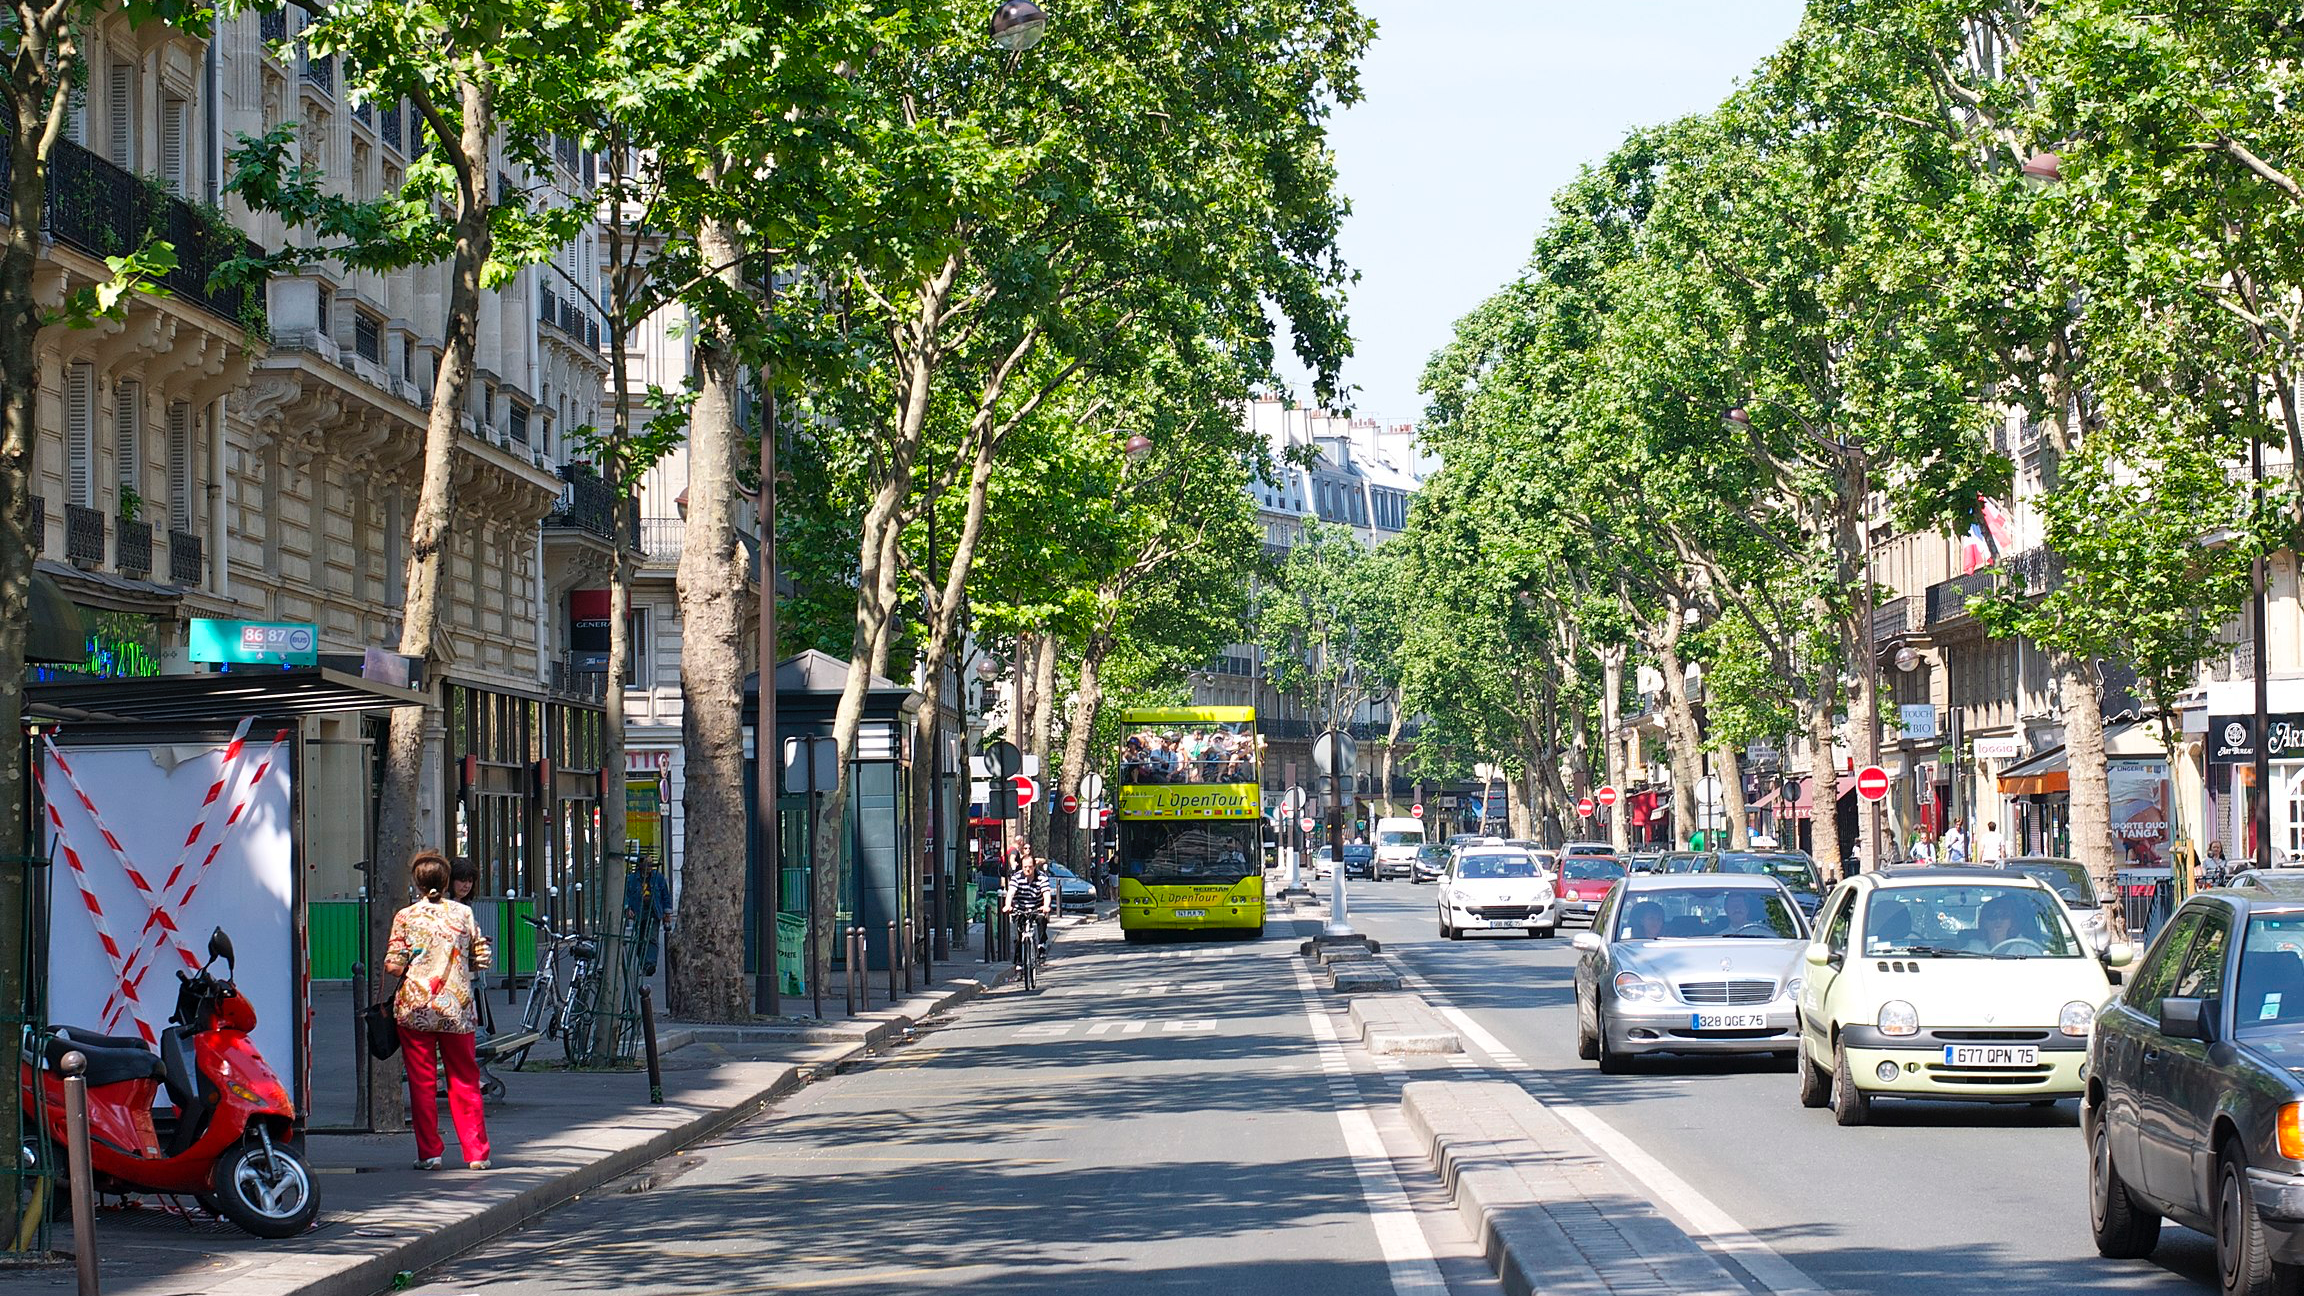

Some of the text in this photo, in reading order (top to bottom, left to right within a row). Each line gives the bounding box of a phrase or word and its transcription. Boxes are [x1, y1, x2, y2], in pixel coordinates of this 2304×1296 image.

[245, 628, 286, 642] 86 87
[292, 636, 308, 644] BUS
[1913, 723, 1931, 733] BIO
[2145, 821, 2168, 829] QUOI
[2120, 829, 2159, 838] TANGA
[1700, 1014, 1764, 1027] 328 QGE 75
[1958, 1049, 2034, 1063] 677 QPN 75
